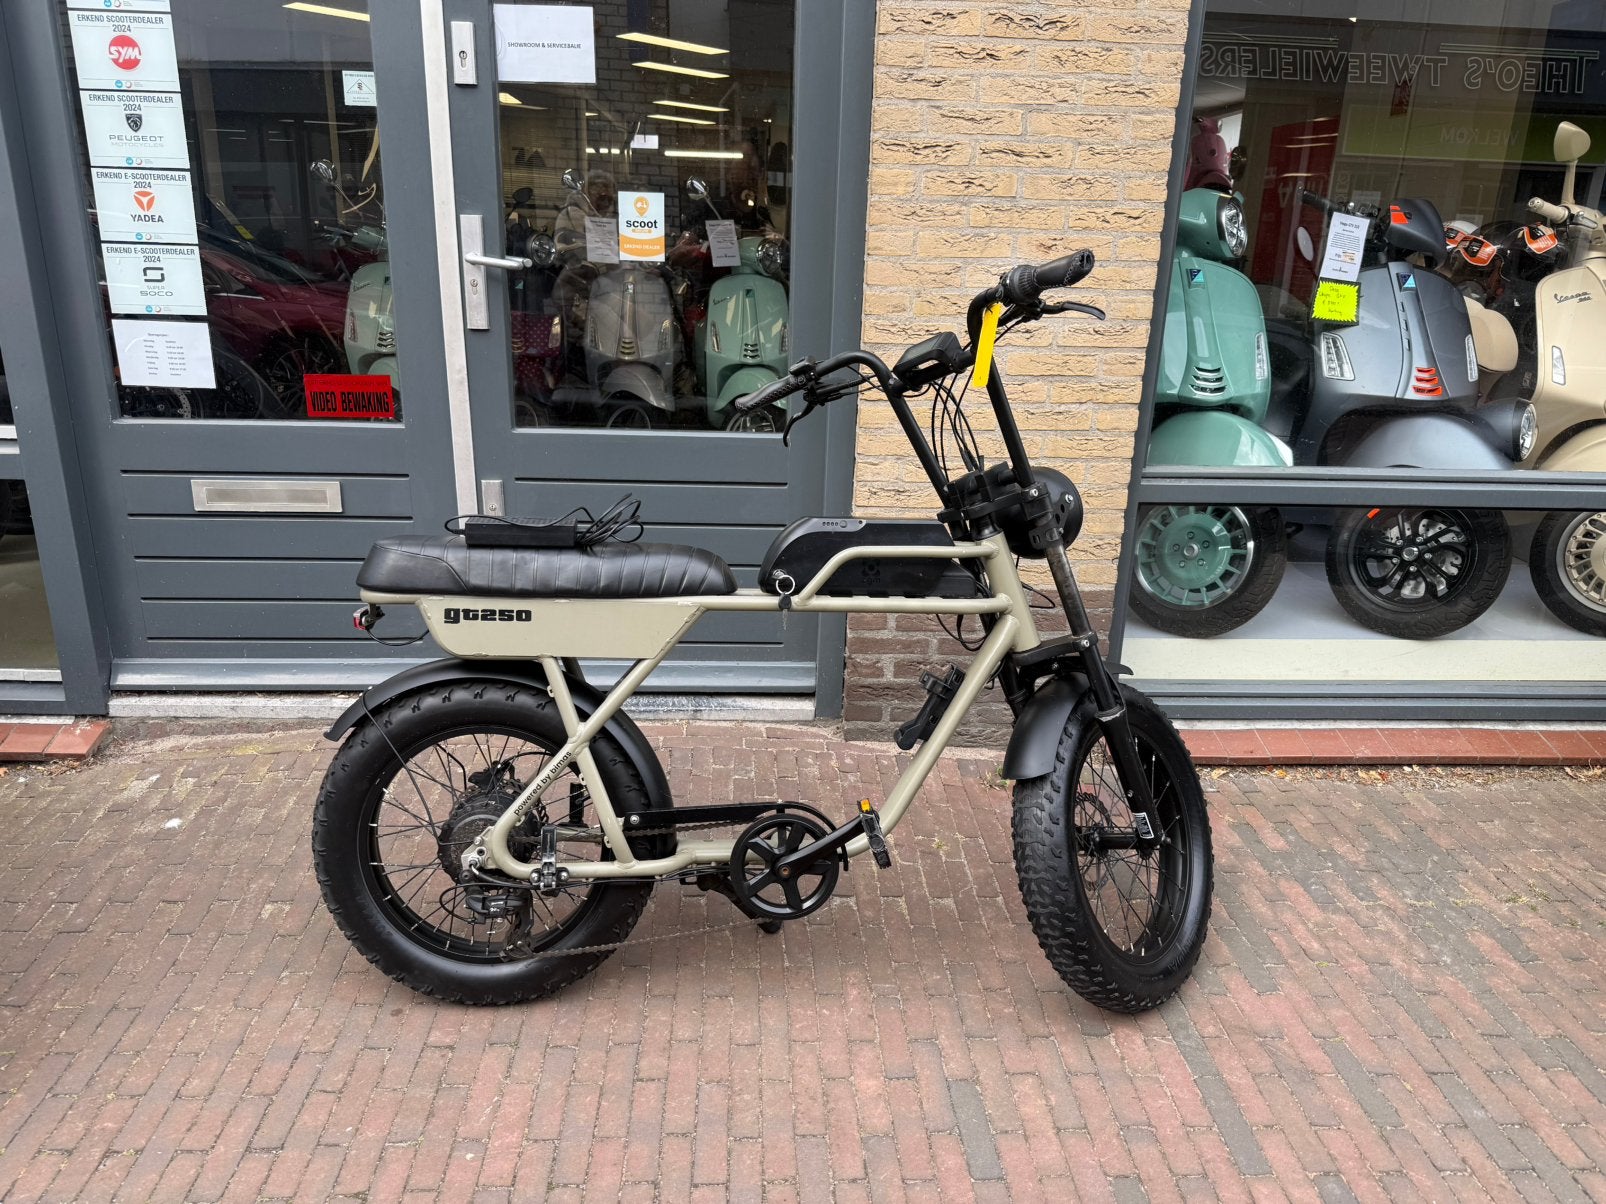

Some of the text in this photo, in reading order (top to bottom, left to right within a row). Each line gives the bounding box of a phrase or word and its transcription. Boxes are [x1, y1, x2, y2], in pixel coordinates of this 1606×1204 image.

[77, 14, 164, 24] ERKEND SCOOTERDEALER
[112, 25, 132, 33] 2024
[108, 45, 142, 63] SYM
[88, 94, 174, 103] ERKEND SCOOTERDEALER
[123, 104, 142, 112] 2024
[124, 173, 186, 181] E-SCOOTERDEALER
[134, 181, 152, 189] 2024
[130, 214, 164, 223] YADEA
[626, 219, 658, 229] scoot
[106, 246, 195, 256] ERKEND E-SCOOTERDEALER
[310, 391, 390, 412] VIDEO BEWAKING
[444, 608, 532, 624] gt250
[514, 751, 572, 816] powered by bimas
